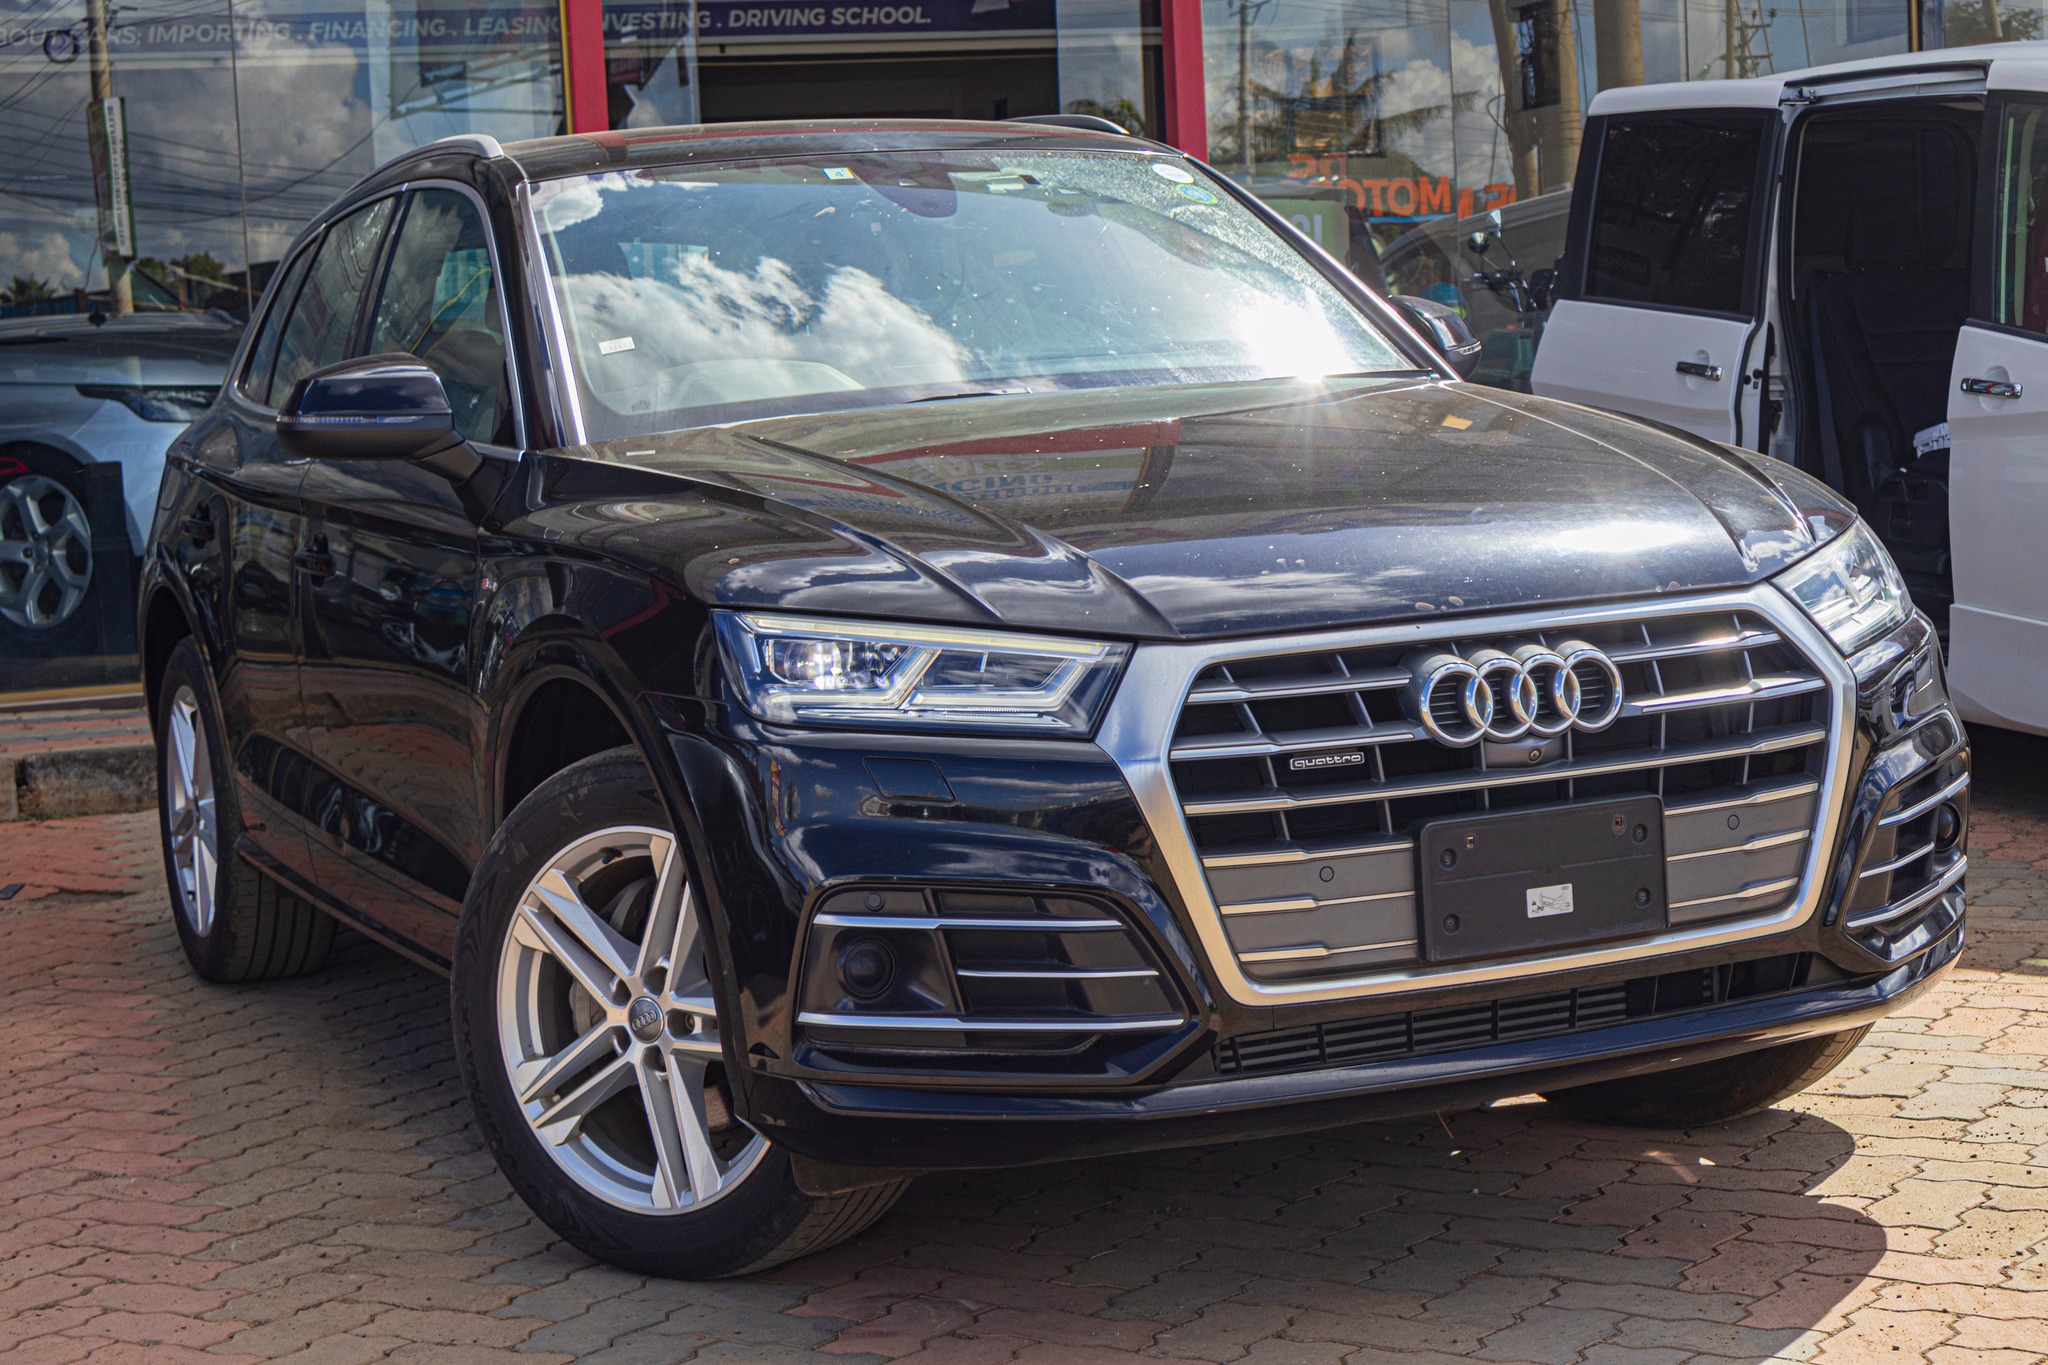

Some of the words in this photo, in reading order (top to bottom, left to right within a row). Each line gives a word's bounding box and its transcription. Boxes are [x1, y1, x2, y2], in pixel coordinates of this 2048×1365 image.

[728, 7, 826, 28] DRIVING
[831, 5, 932, 27] SCHOOL.
[1293, 754, 1361, 768] quattro
